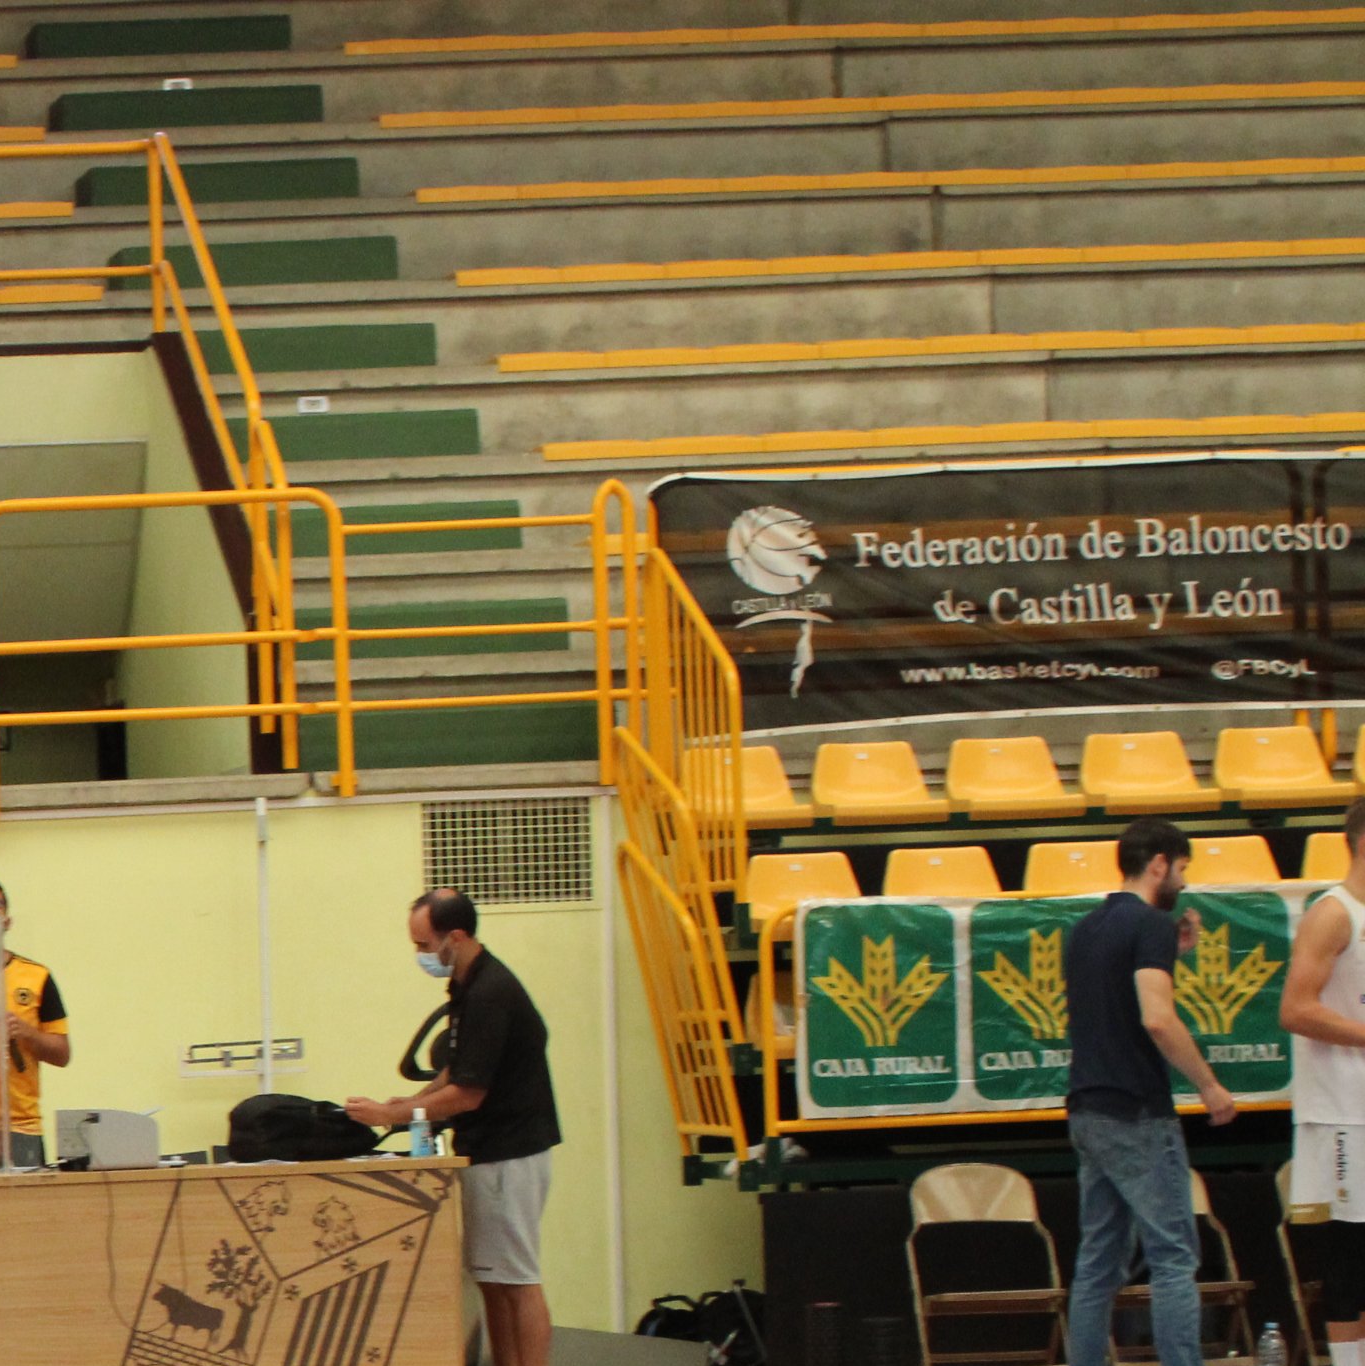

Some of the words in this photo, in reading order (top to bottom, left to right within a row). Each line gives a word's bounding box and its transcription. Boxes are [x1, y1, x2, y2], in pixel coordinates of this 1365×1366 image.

[853, 522, 1067, 567] Federación
[1080, 519, 1125, 558] de
[1135, 515, 1352, 558] Baloncesto
[933, 588, 975, 623] de
[989, 581, 1137, 626] Castilla
[1148, 590, 1173, 629] y
[1182, 578, 1284, 619] León
[980, 1050, 1036, 1072] CAJA
[1209, 1042, 1287, 1064] RURAL
[814, 1058, 869, 1078] CAJA
[873, 1055, 952, 1076] RURAL
